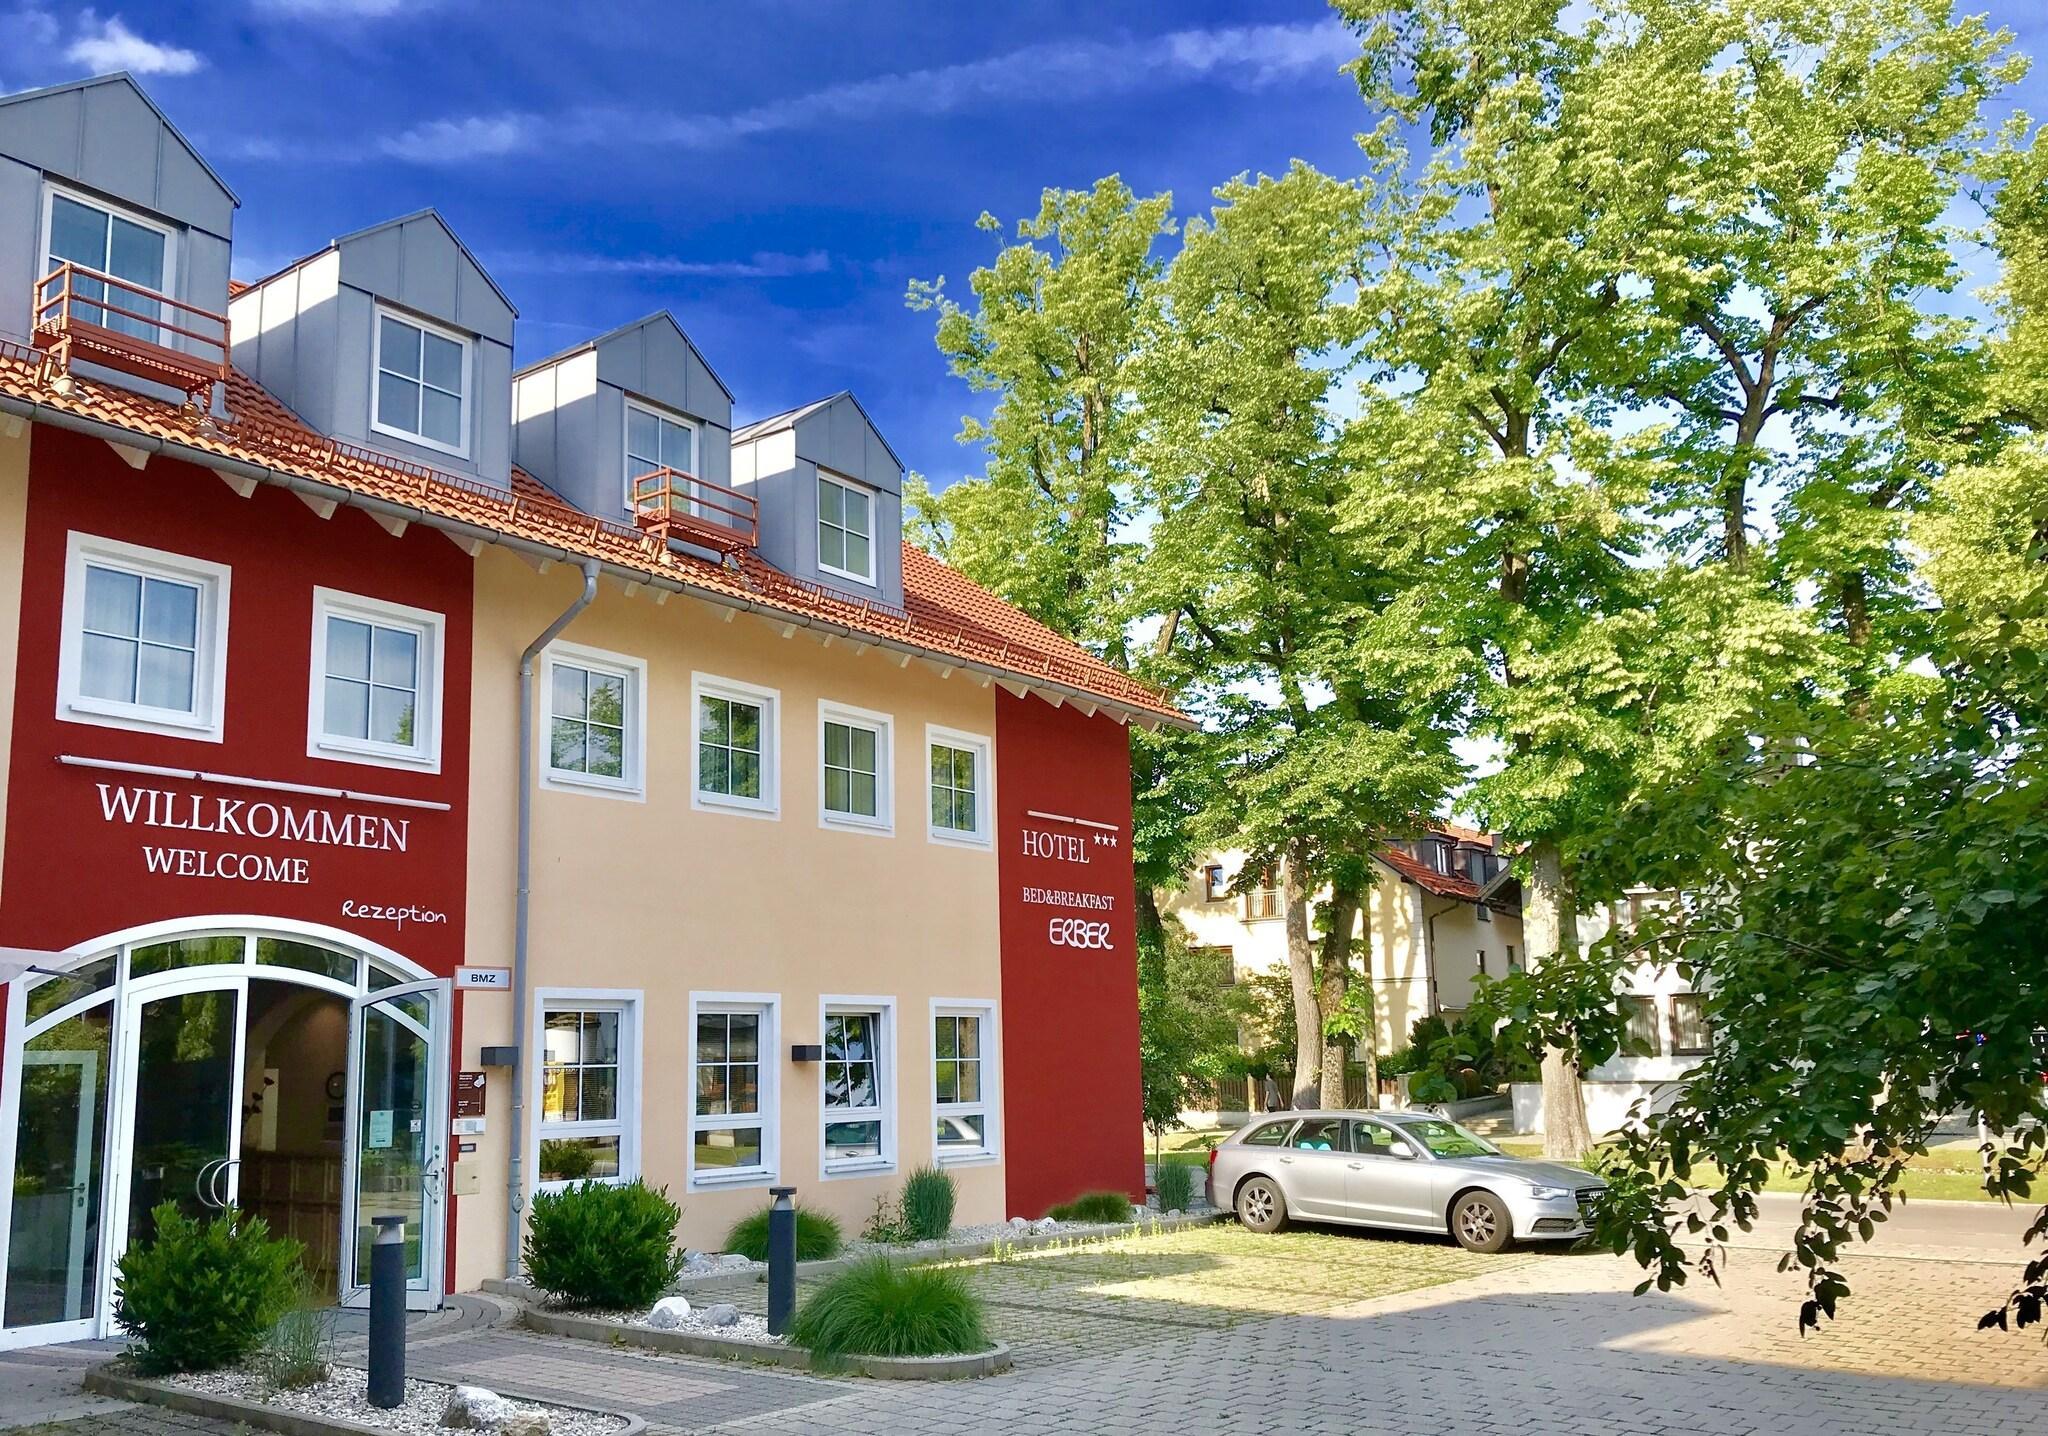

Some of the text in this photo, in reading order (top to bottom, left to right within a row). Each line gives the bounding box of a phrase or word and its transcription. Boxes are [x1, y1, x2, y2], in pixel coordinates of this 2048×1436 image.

[96, 784, 410, 851] WILLKOMMEN
[1022, 830, 1090, 864] HOTEL
[142, 847, 309, 883] WELCOME
[341, 899, 447, 932] Rezeption
[1022, 887, 1115, 911] BED&BREAKFAST
[1049, 917, 1114, 950] ERBER
[471, 973, 496, 983] BMZ
